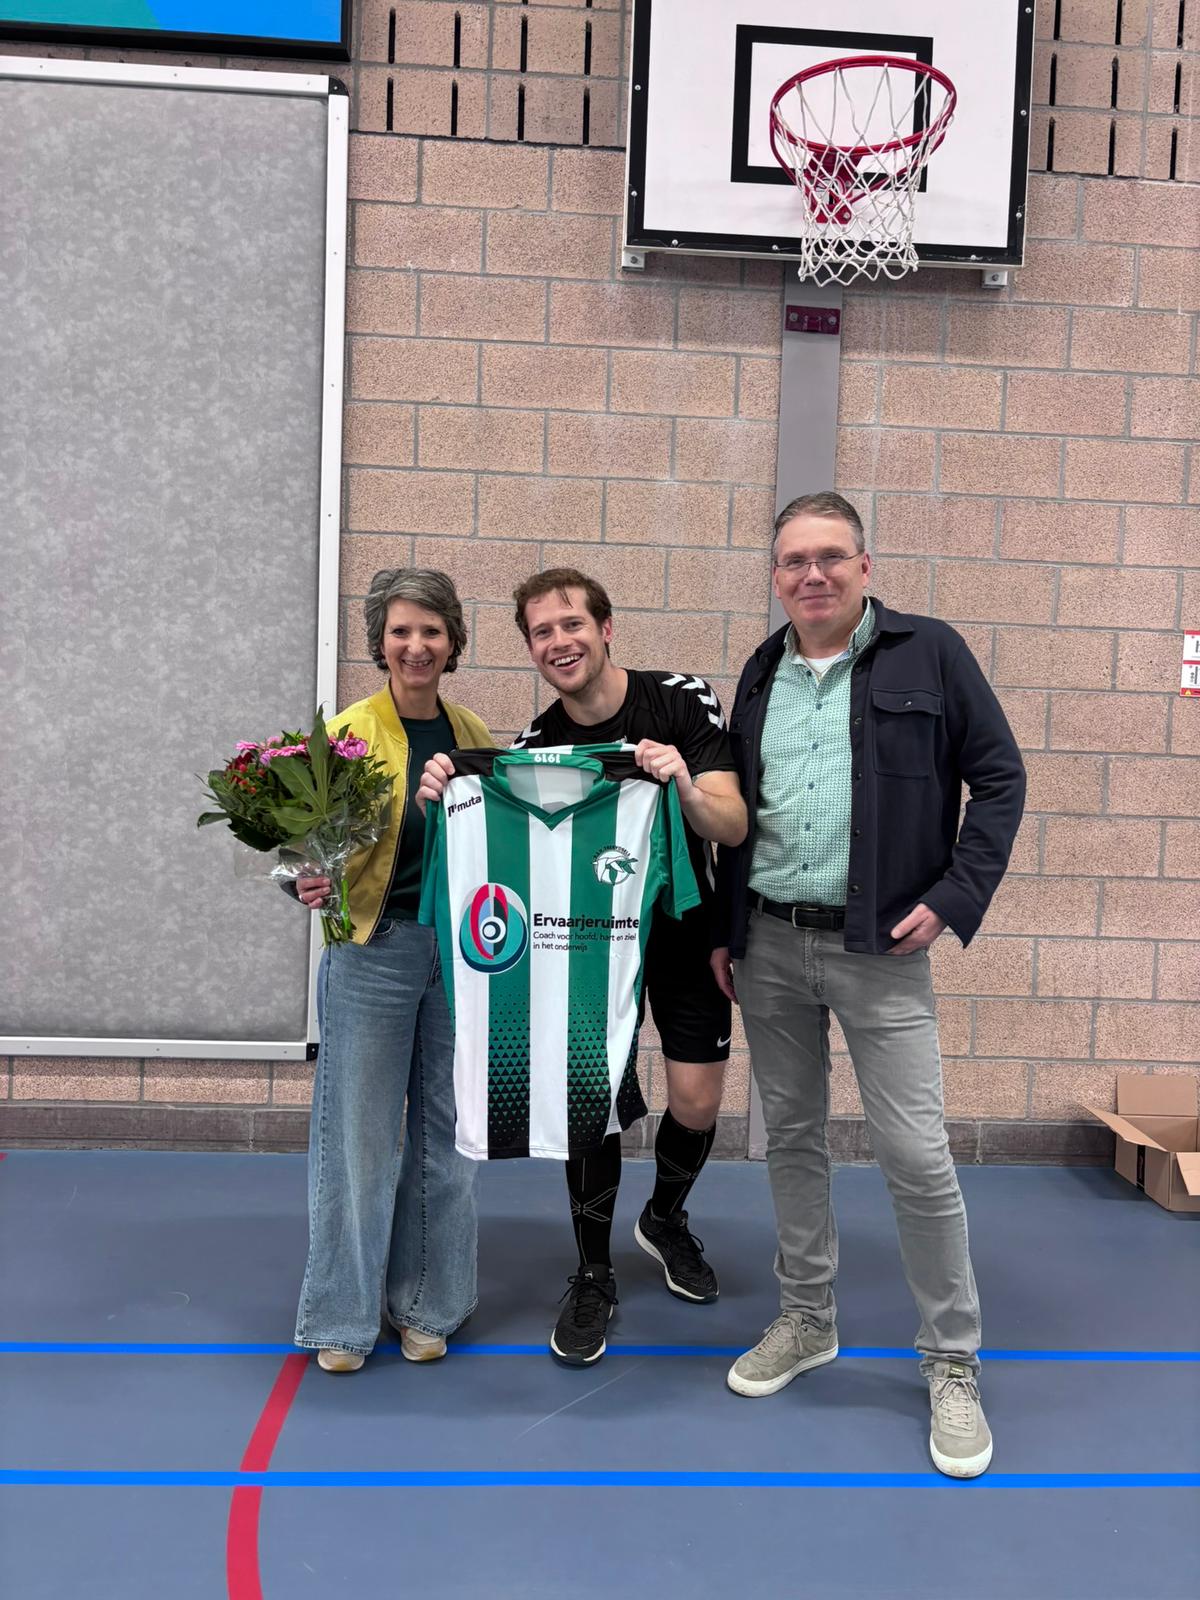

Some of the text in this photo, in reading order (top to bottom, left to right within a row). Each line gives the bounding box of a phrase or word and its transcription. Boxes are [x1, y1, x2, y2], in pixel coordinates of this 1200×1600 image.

[457, 795, 482, 812] muta
[533, 913, 639, 931] Ervaarjeruimte
[533, 931, 556, 939] Coach
[599, 933, 615, 941] hart
[624, 933, 637, 941] ziel
[541, 942, 554, 950] het
[554, 942, 588, 953] onderwijs
